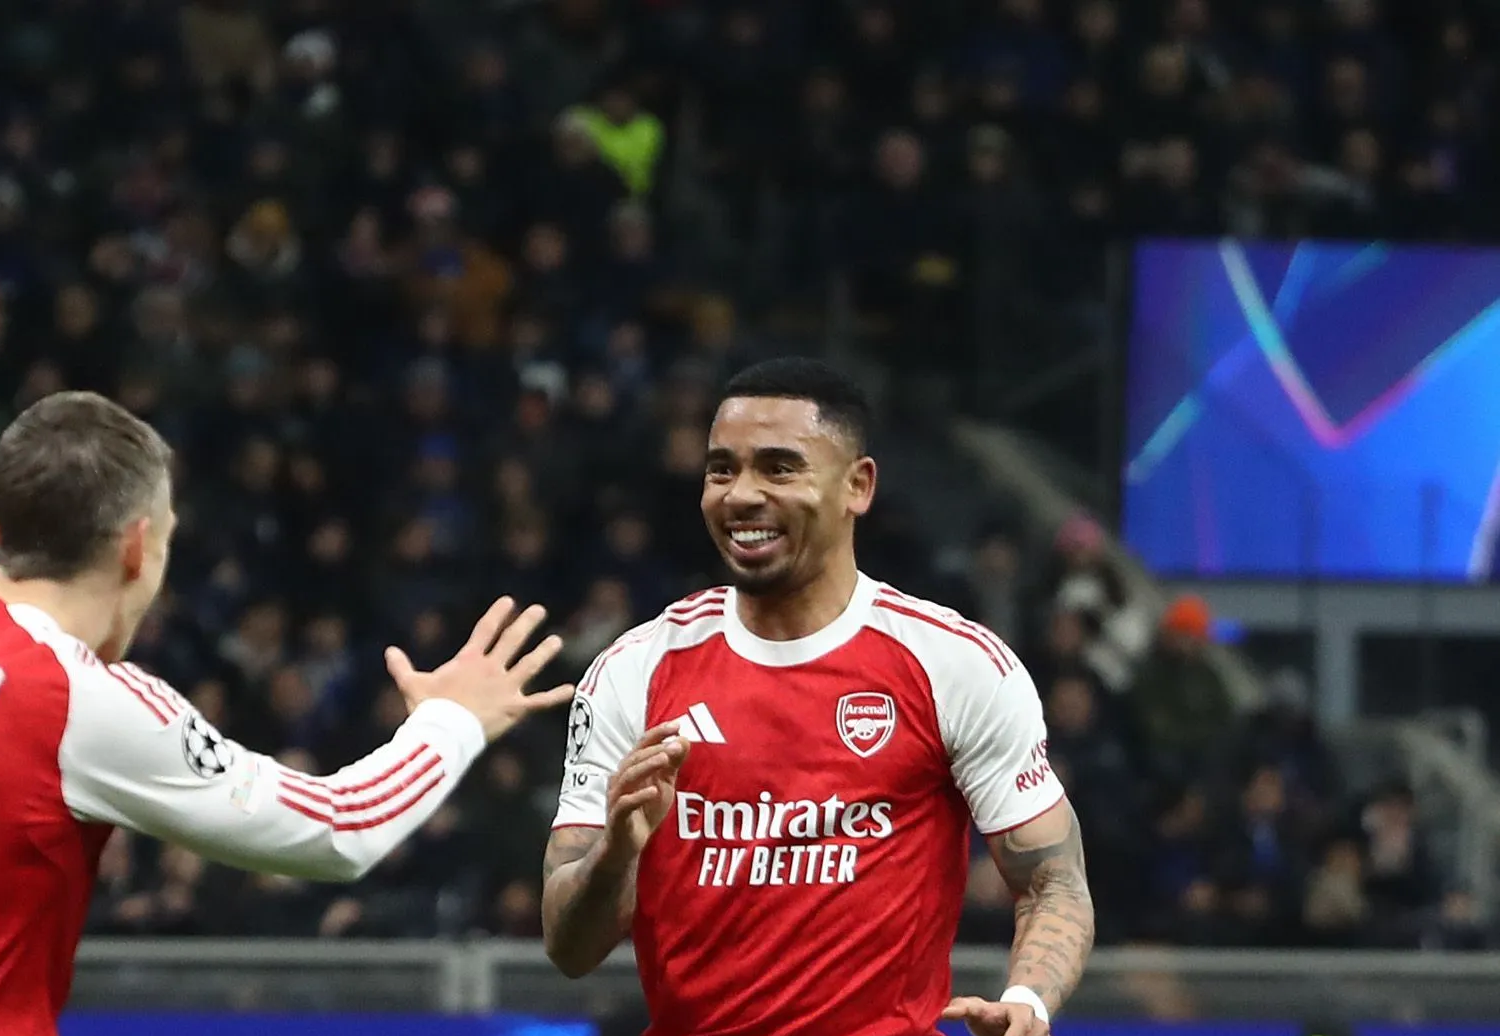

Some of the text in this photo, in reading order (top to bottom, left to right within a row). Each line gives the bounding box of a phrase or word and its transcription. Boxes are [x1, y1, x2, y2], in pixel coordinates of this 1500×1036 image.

[845, 704, 887, 715] Arsenal
[676, 791, 893, 841] Emirates
[698, 844, 858, 887] FLY BETTER
